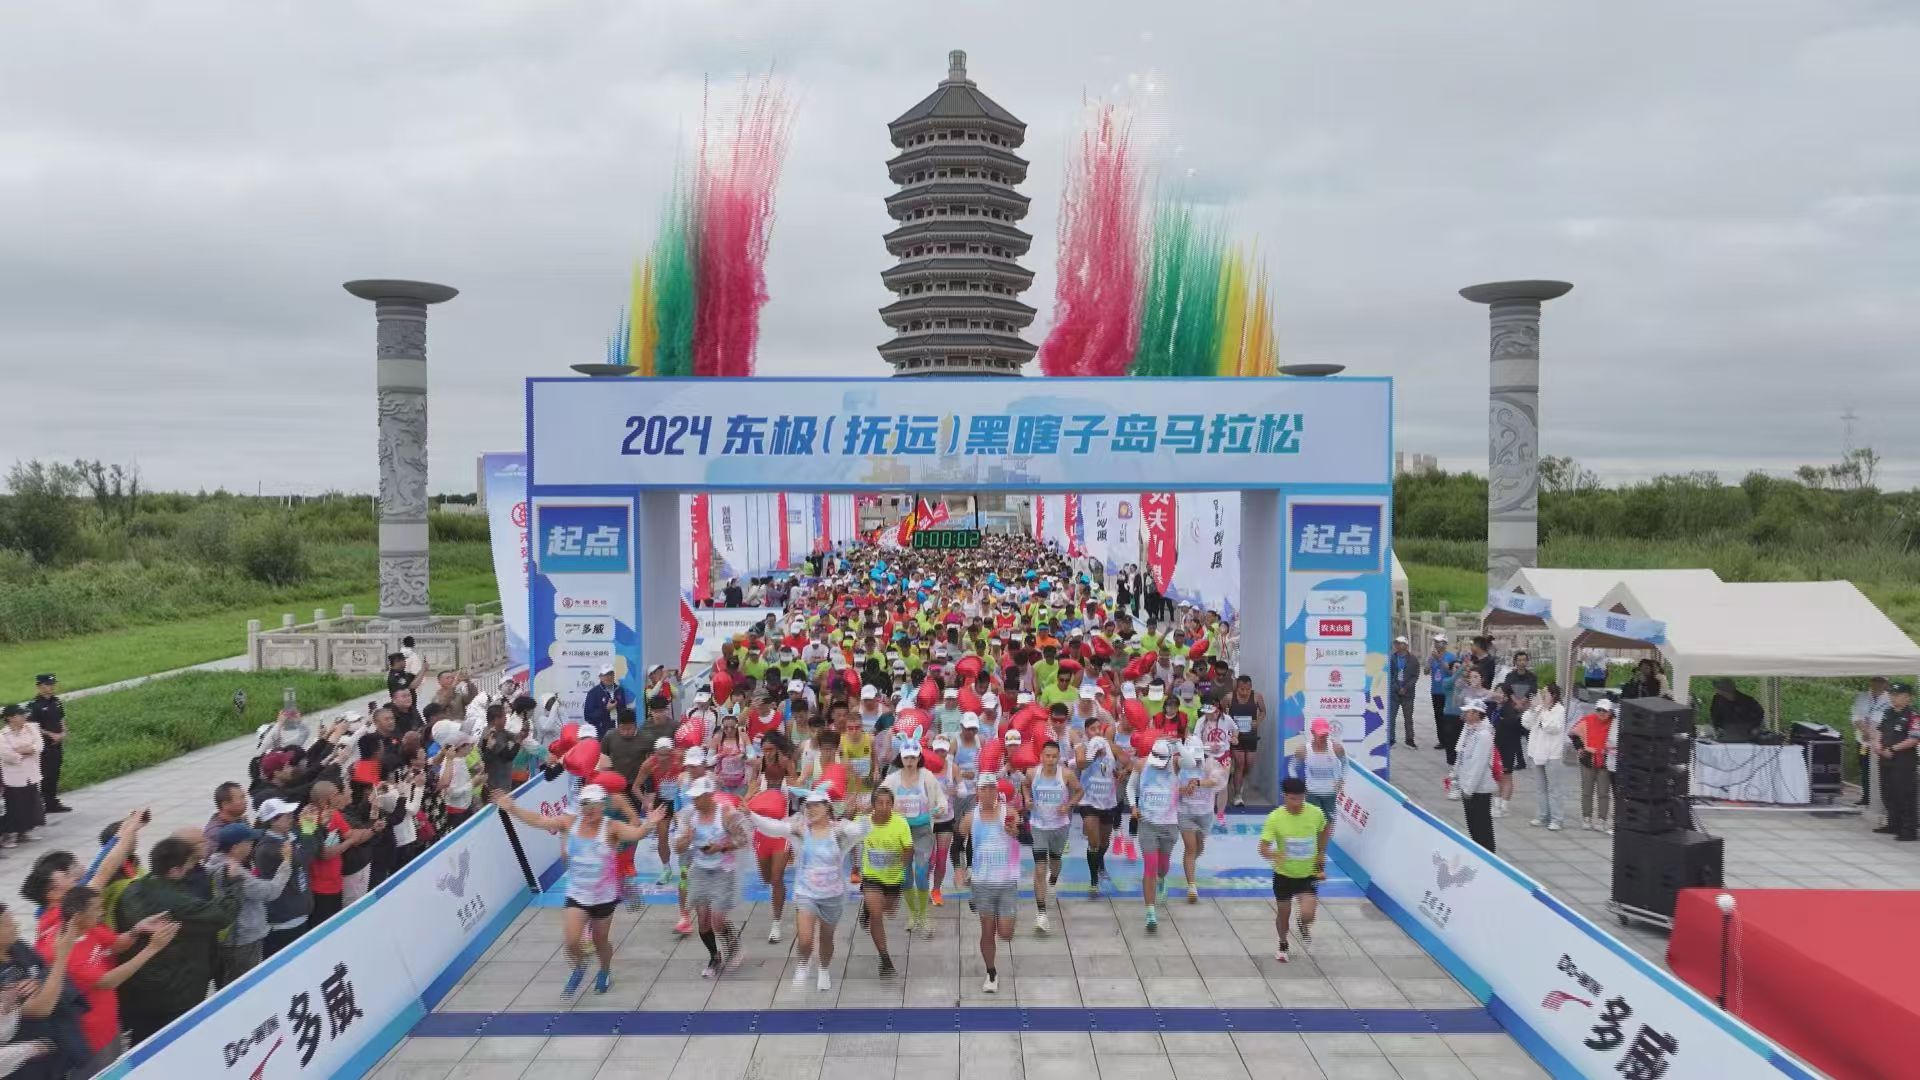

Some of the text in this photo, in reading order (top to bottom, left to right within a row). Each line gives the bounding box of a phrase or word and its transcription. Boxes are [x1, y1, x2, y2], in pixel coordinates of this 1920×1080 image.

[546, 525, 621, 556] 起点
[914, 531, 980, 548] 0:00:02
[1299, 524, 1373, 555] 起点
[287, 961, 364, 1069] 多威
[1583, 995, 1680, 1080] 多威
